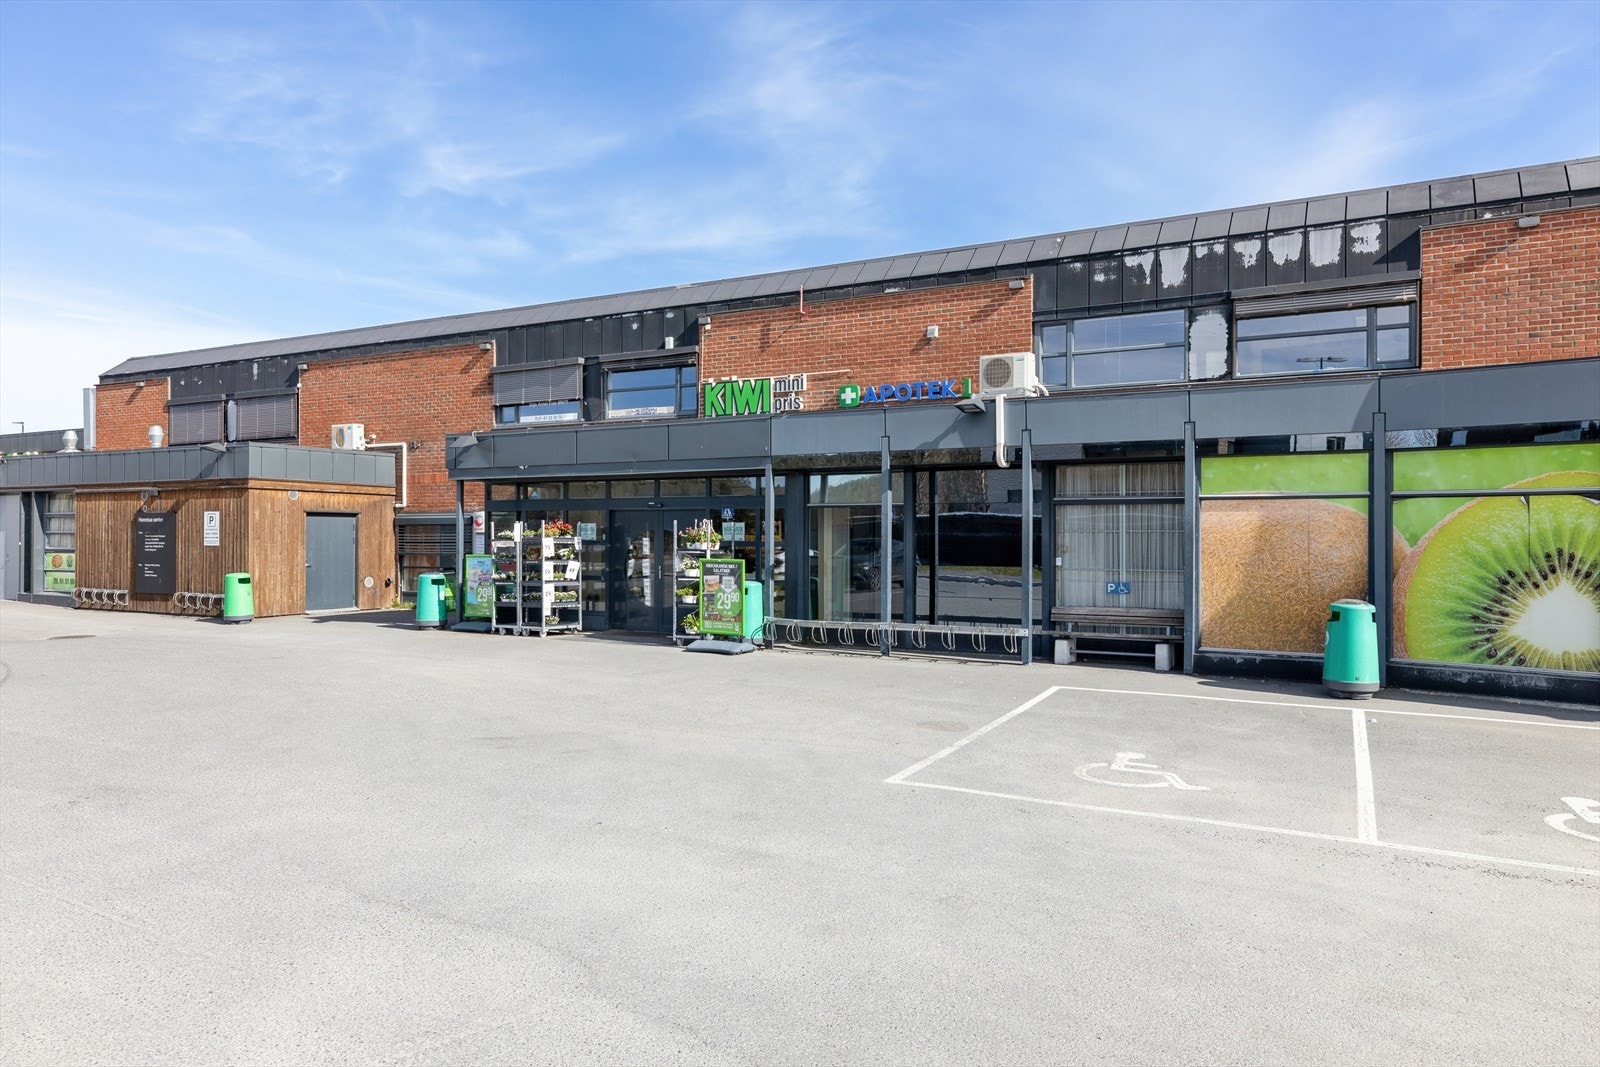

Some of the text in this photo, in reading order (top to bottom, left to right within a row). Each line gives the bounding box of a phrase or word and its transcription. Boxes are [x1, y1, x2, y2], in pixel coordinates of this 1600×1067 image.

[774, 373, 804, 392] mini
[863, 378, 971, 404] APOTEK 1
[704, 378, 771, 417] KIWI
[774, 393, 801, 412] pris
[208, 515, 214, 525] P
[1107, 583, 1115, 592] P
